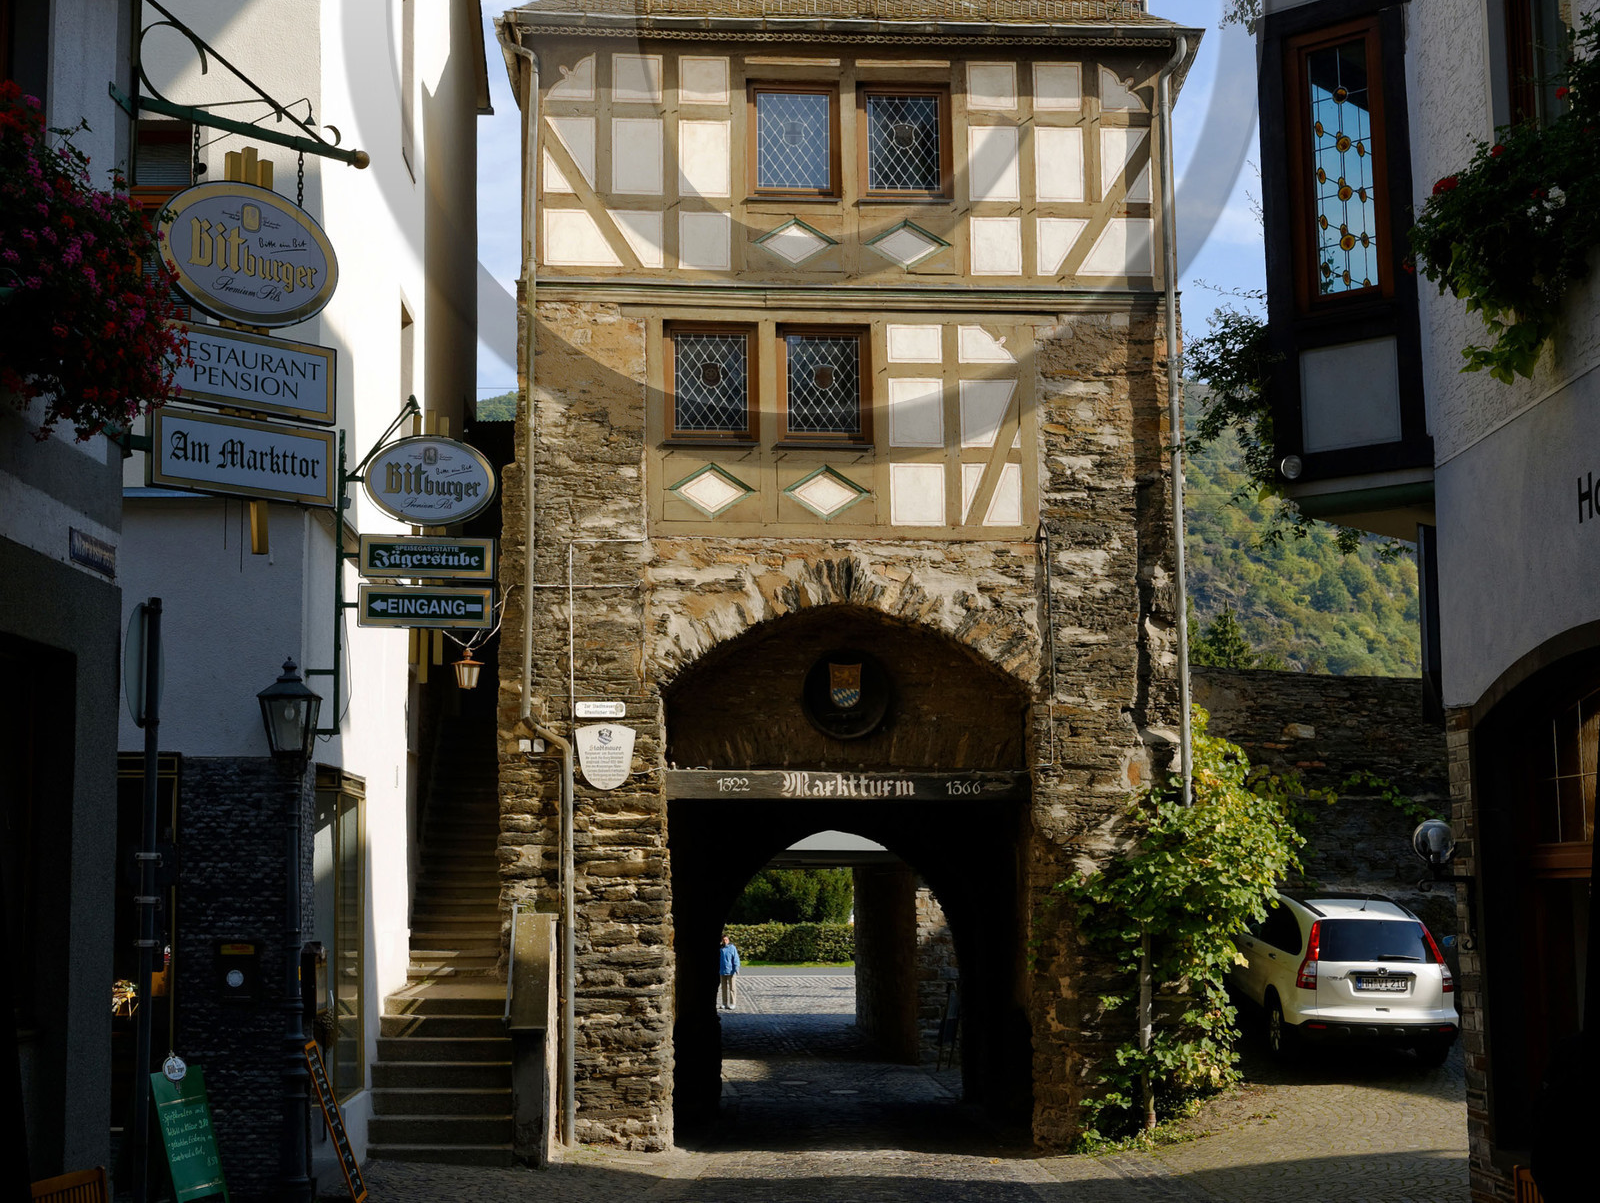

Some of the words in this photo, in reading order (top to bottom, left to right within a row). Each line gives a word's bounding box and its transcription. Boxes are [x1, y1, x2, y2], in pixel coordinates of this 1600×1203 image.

[187, 216, 318, 293] Bitburger
[258, 237, 276, 249] Bitte
[280, 241, 292, 249] ein
[293, 238, 307, 248] Bit
[212, 275, 256, 297] Premium
[256, 284, 281, 302] Pils
[193, 364, 299, 400] PENSION
[170, 430, 210, 464] Am
[216, 438, 320, 479] Markttor
[383, 461, 482, 503] Bitburger
[401, 497, 434, 509] Premium
[434, 498, 453, 509] Pils
[372, 549, 481, 568] Jägerstube
[387, 599, 466, 616] EINGANG
[717, 777, 750, 793] 1322
[780, 772, 916, 797] Marktturm
[946, 780, 981, 795] 1366
